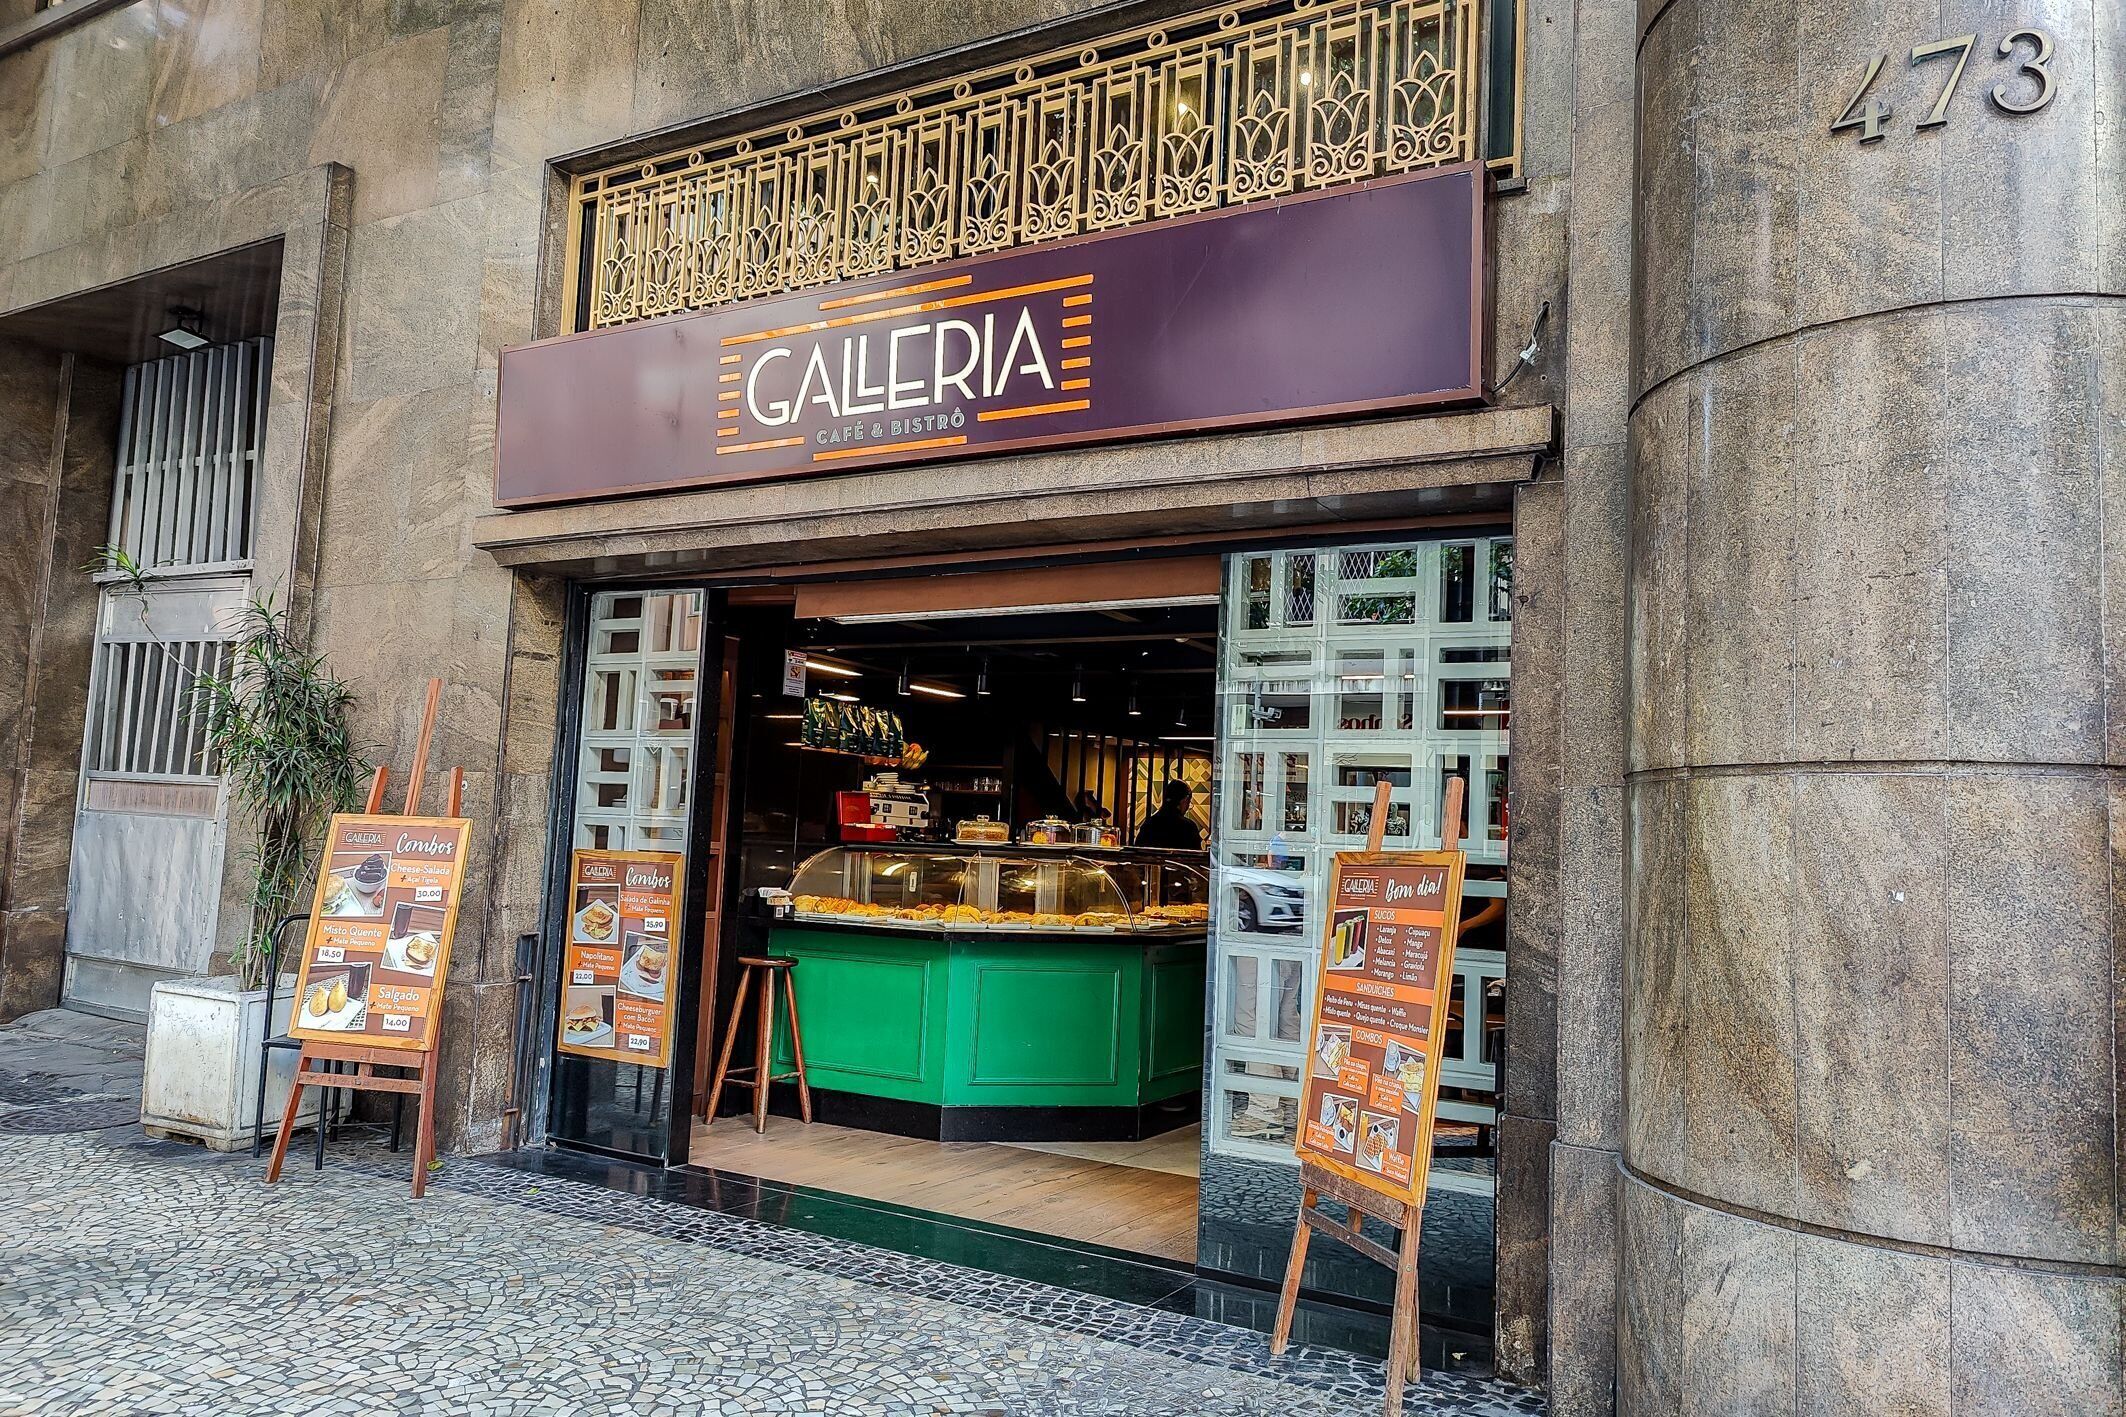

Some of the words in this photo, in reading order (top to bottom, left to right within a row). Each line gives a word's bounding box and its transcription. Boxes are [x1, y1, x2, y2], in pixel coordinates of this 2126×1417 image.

[1830, 27, 2058, 145] 473
[746, 305, 1055, 427] GALLERIA
[816, 420, 865, 445] CAFÉ
[870, 422, 882, 438] &
[890, 406, 966, 437] BISTRÔ
[345, 832, 382, 844] GALLERIA
[396, 832, 455, 856] Combos
[390, 863, 450, 875] Cheese-Salada
[625, 866, 671, 888] Combos
[1344, 878, 1375, 893] GALLERIA
[1385, 879, 1415, 902] Bom
[1417, 872, 1443, 896] dia!
[620, 894, 639, 903] Salada
[640, 896, 647, 904] de
[648, 896, 671, 906] Galinha
[1374, 909, 1395, 920] SUCOS
[323, 925, 347, 935] Misto
[350, 925, 382, 937] Quente
[1379, 925, 1397, 936] Laranja
[333, 937, 349, 945] Mate
[350, 938, 376, 946] Pequeno
[321, 949, 342, 958] 18,50
[580, 950, 615, 962] Napolitano
[594, 962, 616, 971] Pequeno
[1403, 960, 1425, 971] Graviola
[1373, 967, 1395, 980] Morango
[1402, 971, 1418, 982] Limão
[378, 986, 420, 1003] Salgado
[376, 1002, 392, 1010] Mate
[393, 1004, 420, 1012] Pequeno
[617, 1002, 662, 1016] Cheeseburguer
[386, 1018, 408, 1027] 14,00
[636, 1013, 655, 1024] Bacon
[1390, 1018, 1408, 1032] Croque
[630, 1038, 648, 1046] 22,90
[1355, 1029, 1383, 1045] COMBOS
[1390, 1152, 1405, 1166] Waffle
